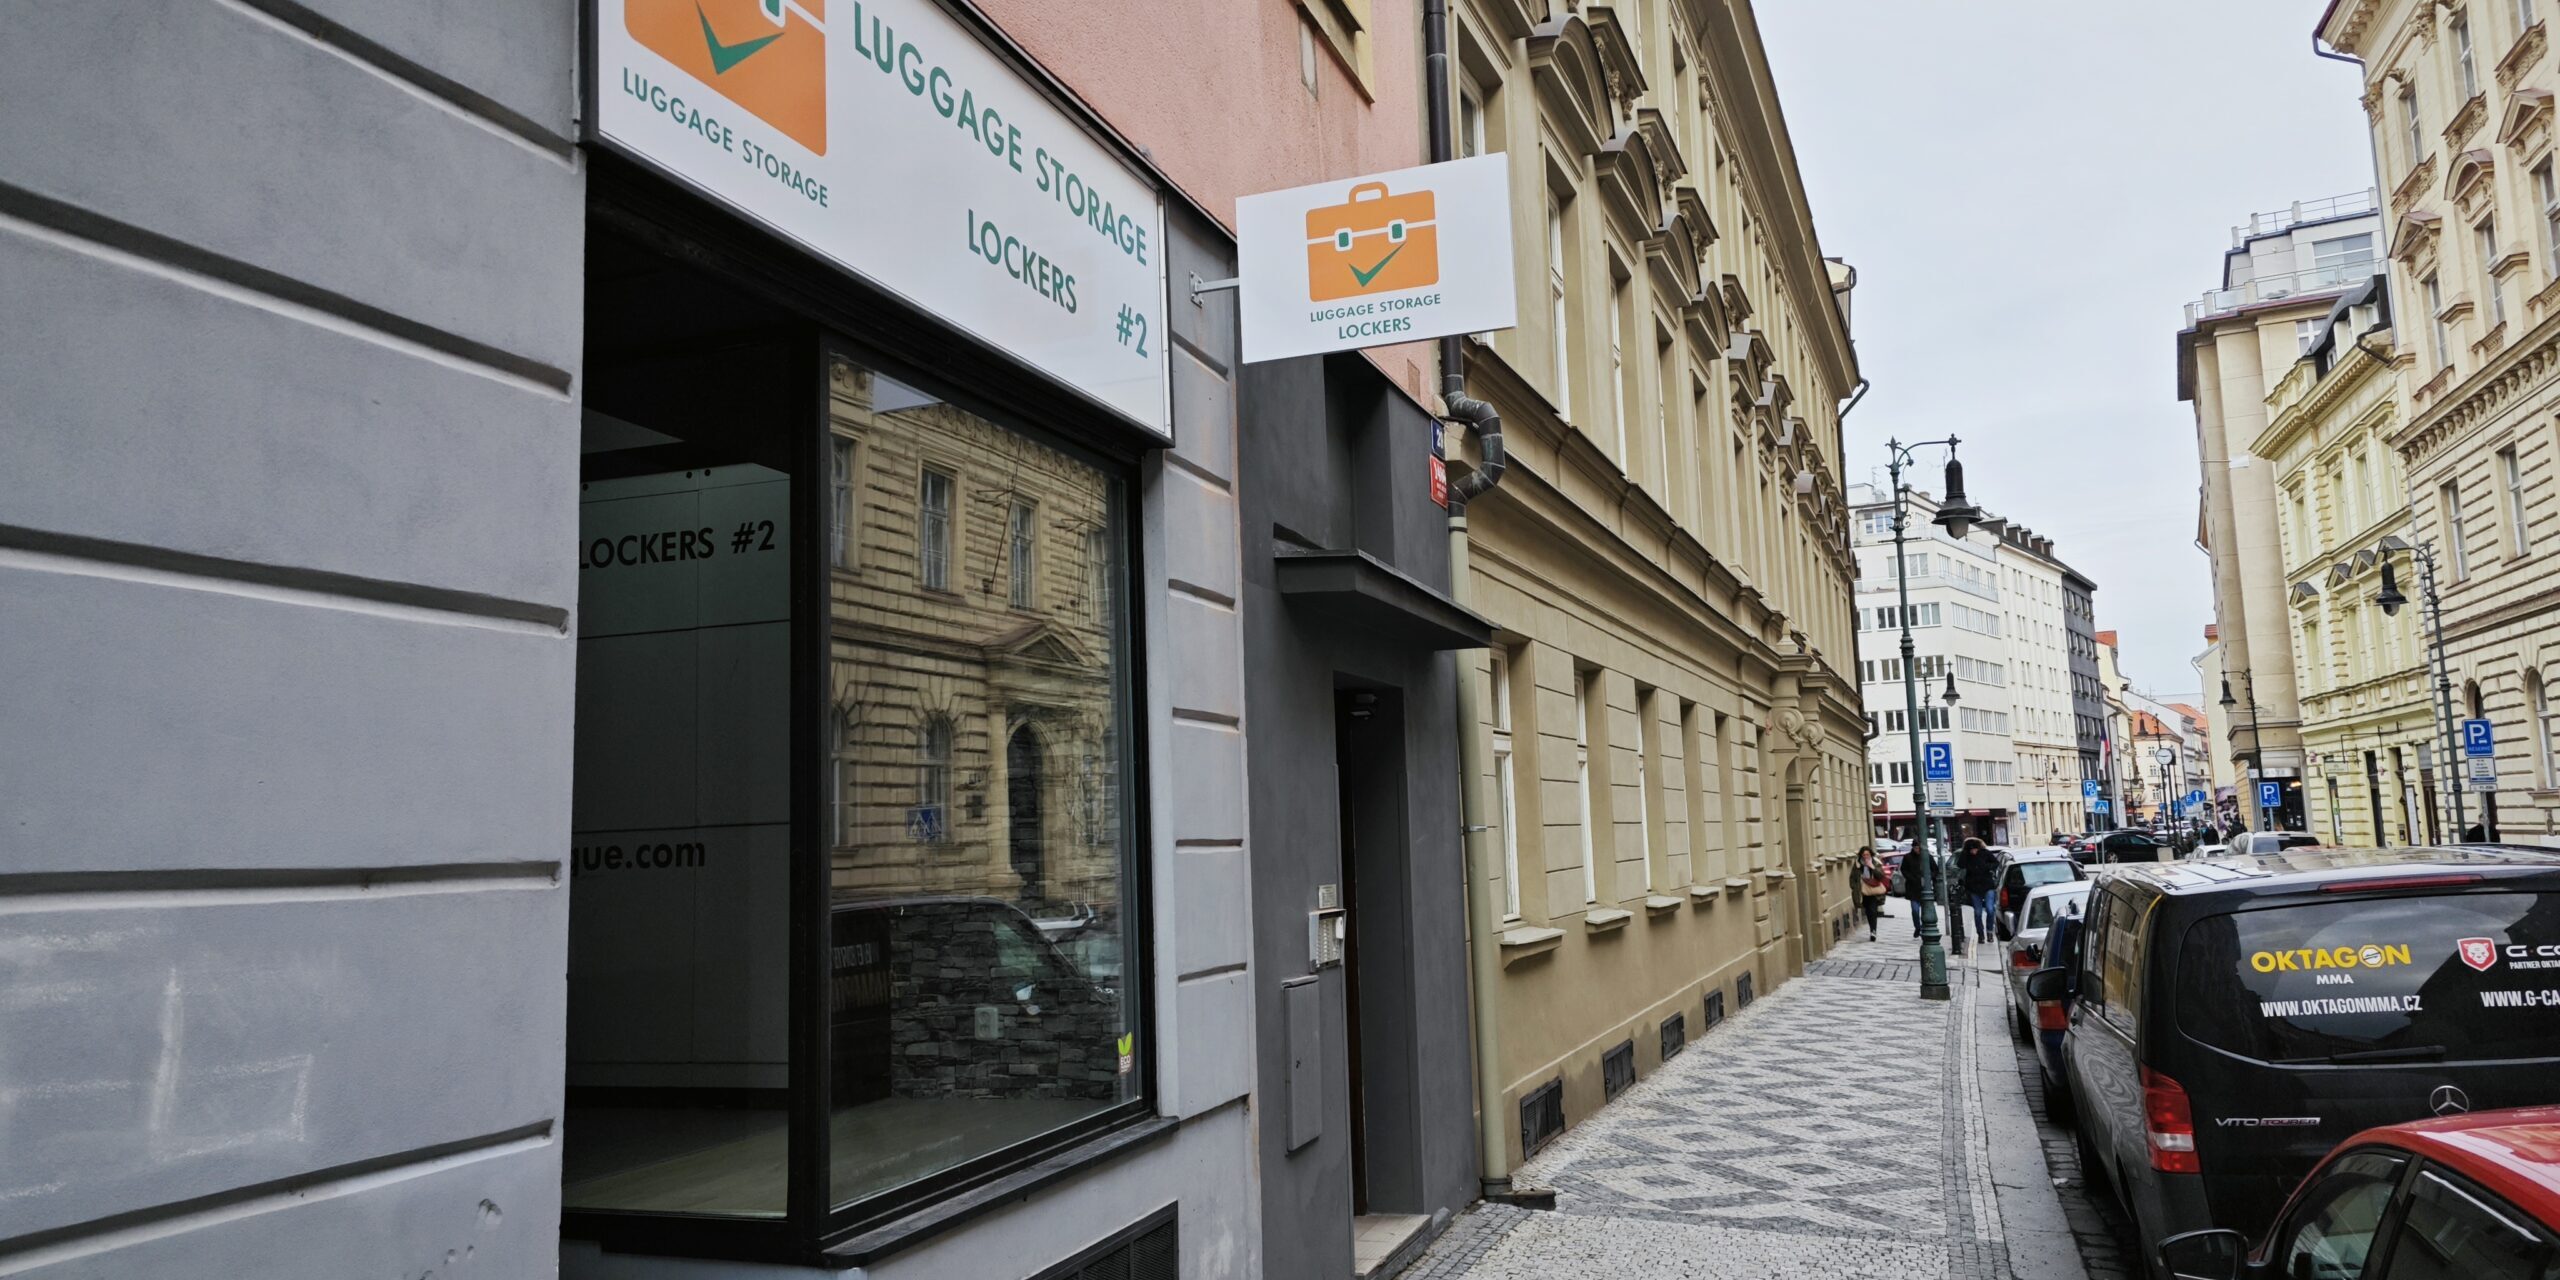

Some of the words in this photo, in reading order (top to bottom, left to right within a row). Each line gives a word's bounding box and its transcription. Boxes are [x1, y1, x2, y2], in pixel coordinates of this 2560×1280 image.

[623, 66, 733, 153] LUGGAGE
[742, 138, 829, 208] STORAGE
[854, 0, 1023, 174] LUGGAGE
[1035, 147, 1148, 267] STORAGE
[968, 208, 1077, 315] LOCKERS
[1310, 303, 1374, 322] LUGGAGE
[1379, 293, 1442, 312] STORAGE
[1116, 302, 1149, 360] #2
[1338, 317, 1411, 340] LOCKERS
[731, 520, 775, 554] #2
[2468, 724, 2486, 745] P
[1930, 746, 1946, 769] P
[2085, 782, 2094, 792] P
[2263, 785, 2275, 800] P
[2251, 943, 2412, 974] OKTAGON
[2509, 961, 2541, 970] PARTNER
[2316, 973, 2354, 986] MMA
[2260, 995, 2423, 1018] WWW.OKTAGONMMA.CZ
[2215, 1117, 2260, 1127] VITO
